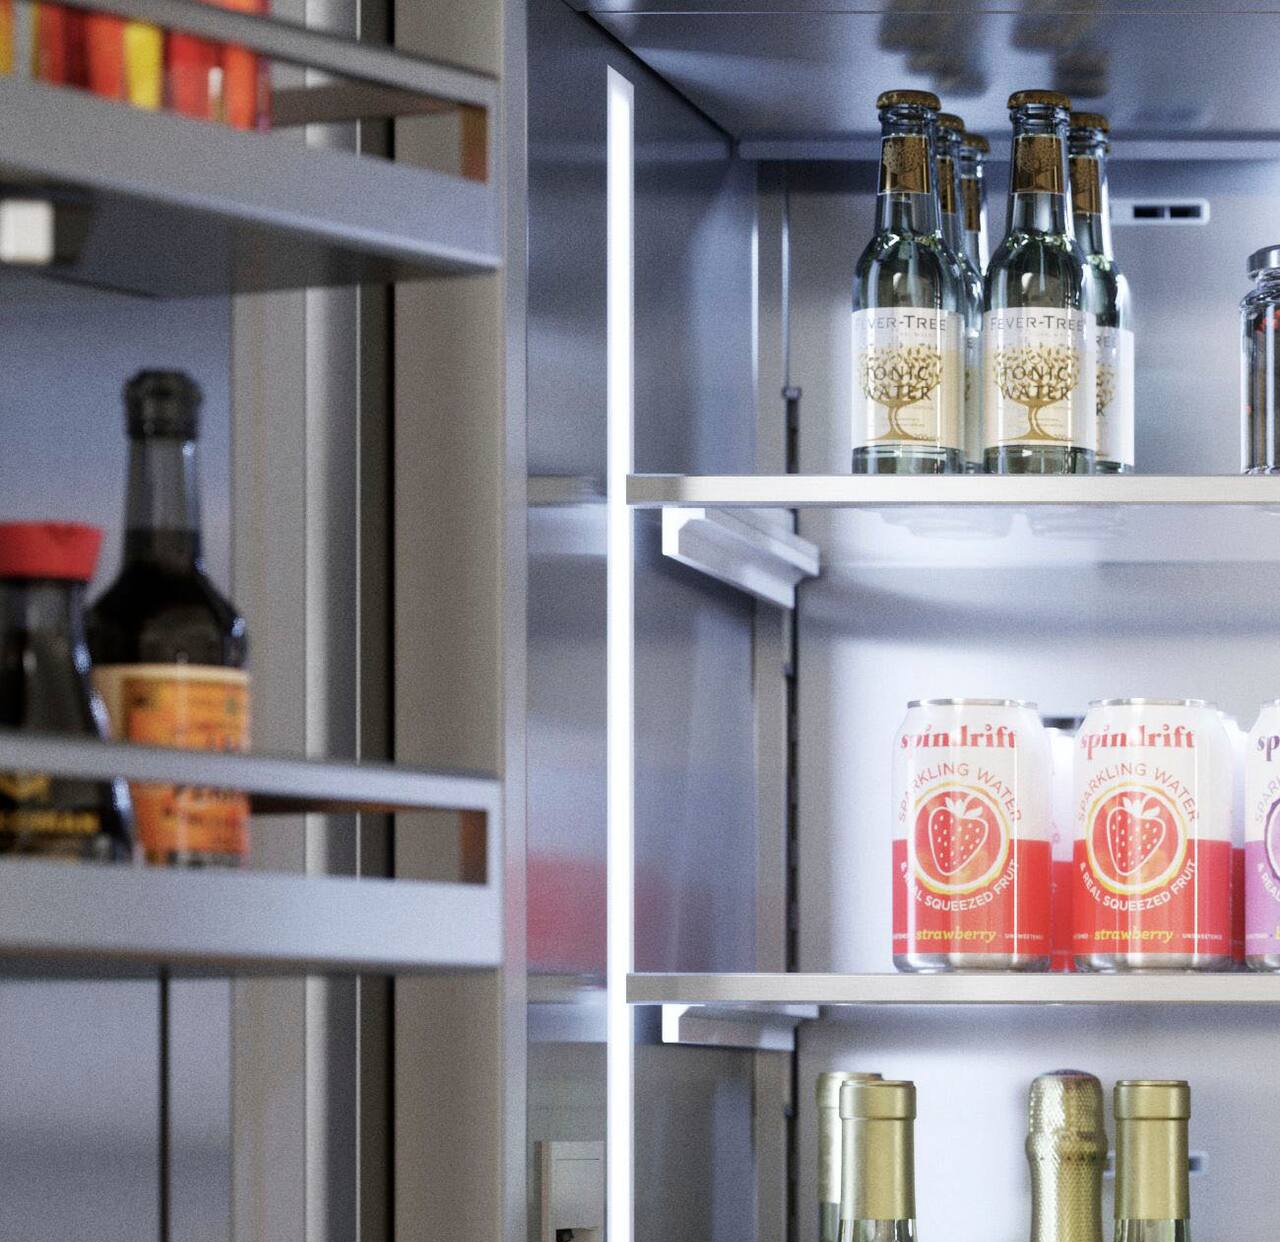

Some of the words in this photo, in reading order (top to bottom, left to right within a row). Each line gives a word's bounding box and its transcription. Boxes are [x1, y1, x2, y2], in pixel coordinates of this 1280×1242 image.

[866, 366, 928, 381] TONIC
[1002, 365, 1068, 381] TONIC
[864, 384, 931, 401] WATER
[1002, 385, 1070, 401] WATER
[1080, 724, 1195, 760] spinrift
[899, 762, 970, 822] SPRKLING
[1078, 762, 1147, 821] SPARKLING
[1153, 767, 1200, 821] WATER
[1082, 872, 1102, 902] REAL
[1103, 891, 1172, 911] SQUEEZED
[1170, 858, 1198, 895] FRUIT
[1261, 873, 1280, 902] REAL
[924, 891, 993, 911] SQUEEZED
[916, 926, 997, 943] strawberry
[1094, 925, 1174, 943] strawberry
